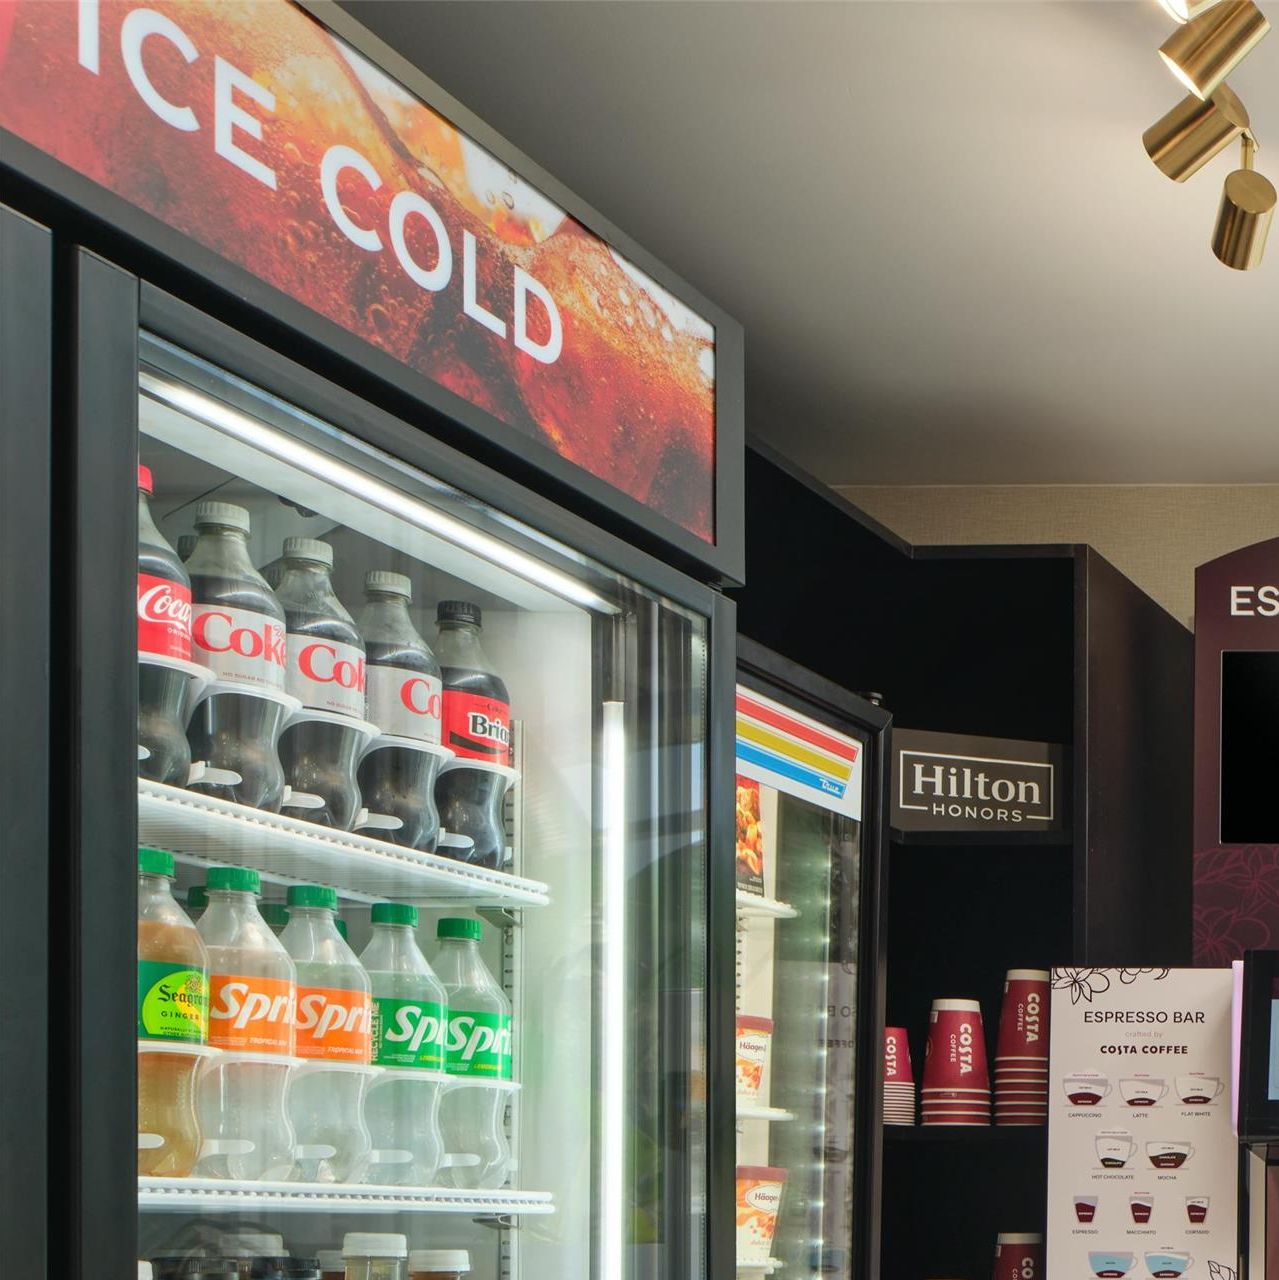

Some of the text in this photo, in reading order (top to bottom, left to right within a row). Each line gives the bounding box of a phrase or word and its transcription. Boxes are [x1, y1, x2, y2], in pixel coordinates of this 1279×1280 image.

[78, 0, 565, 365] ICE COLD
[913, 763, 1041, 805] Hilton
[932, 802, 1022, 822] HONORS
[1024, 992, 1041, 1043] COSTA
[1083, 1011, 1205, 1024] ESPRESSO BAR
[885, 1036, 897, 1076] COSTA
[958, 1023, 973, 1074] COSTA
[1100, 1045, 1188, 1055] COSTA COFFEE
